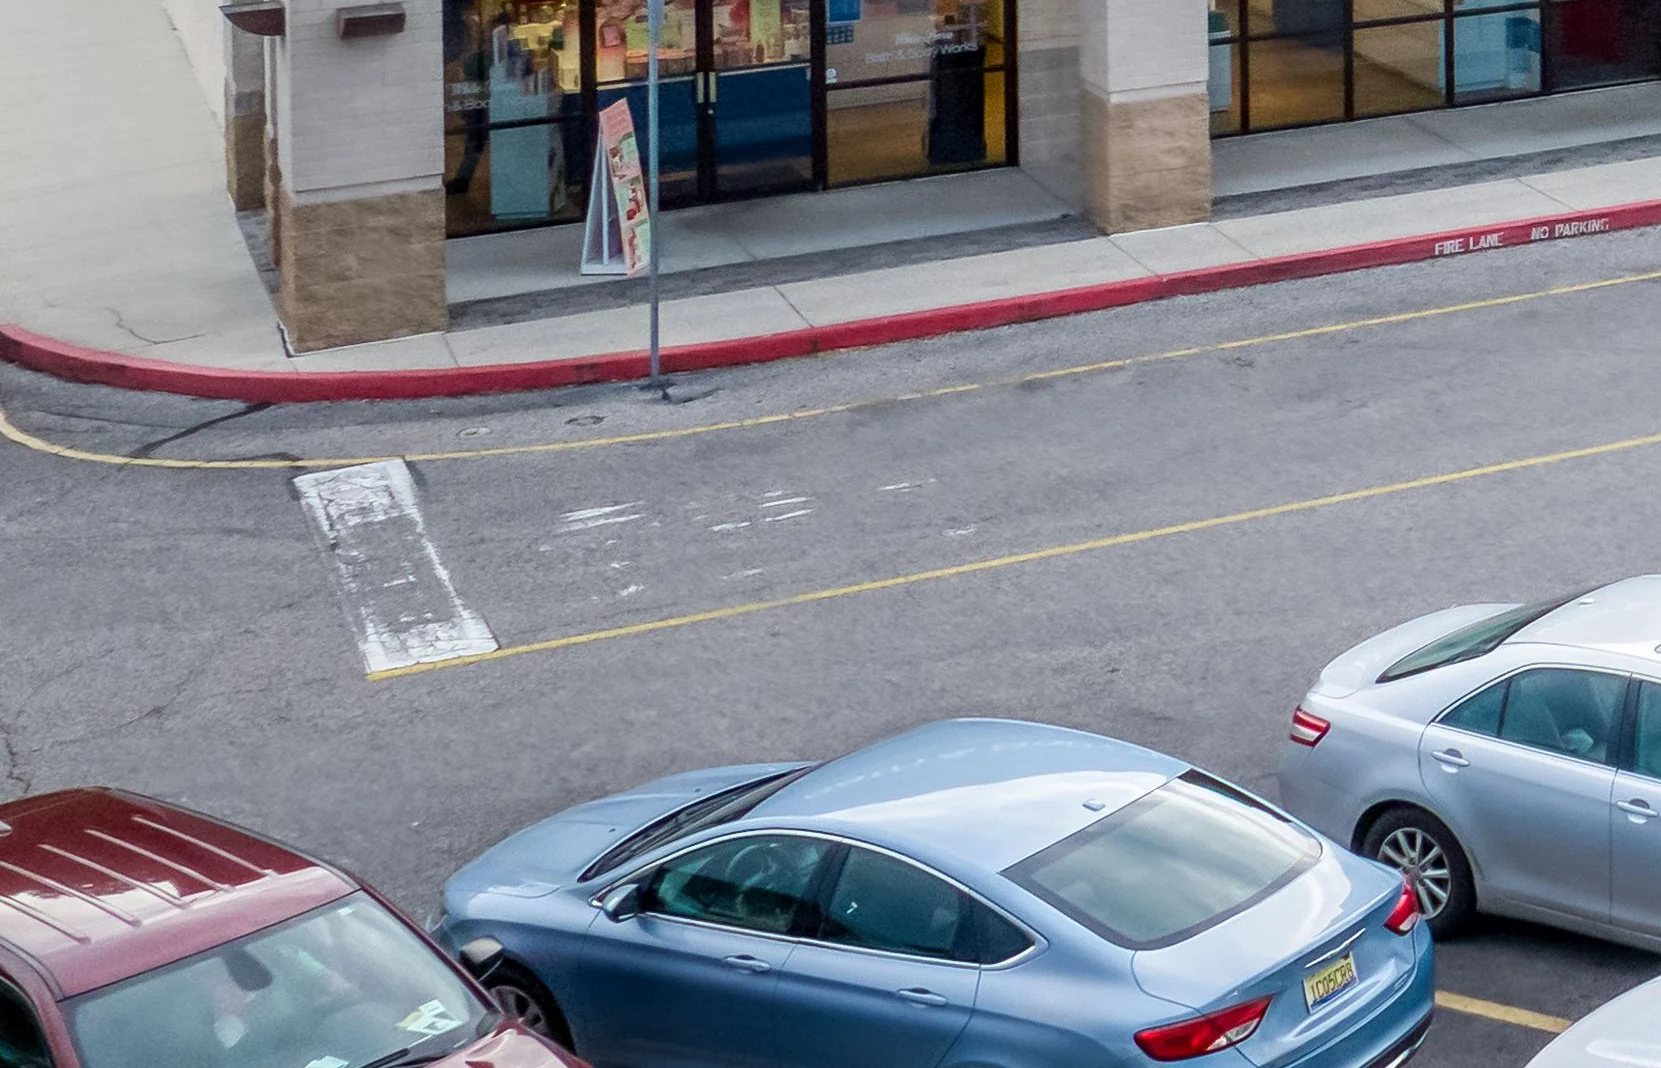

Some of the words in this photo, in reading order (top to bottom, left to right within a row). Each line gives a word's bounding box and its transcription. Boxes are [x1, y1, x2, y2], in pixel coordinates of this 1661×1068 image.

[1434, 238, 1465, 256] FIRE
[1531, 226, 1550, 240] NO
[1555, 218, 1610, 238] PARKING
